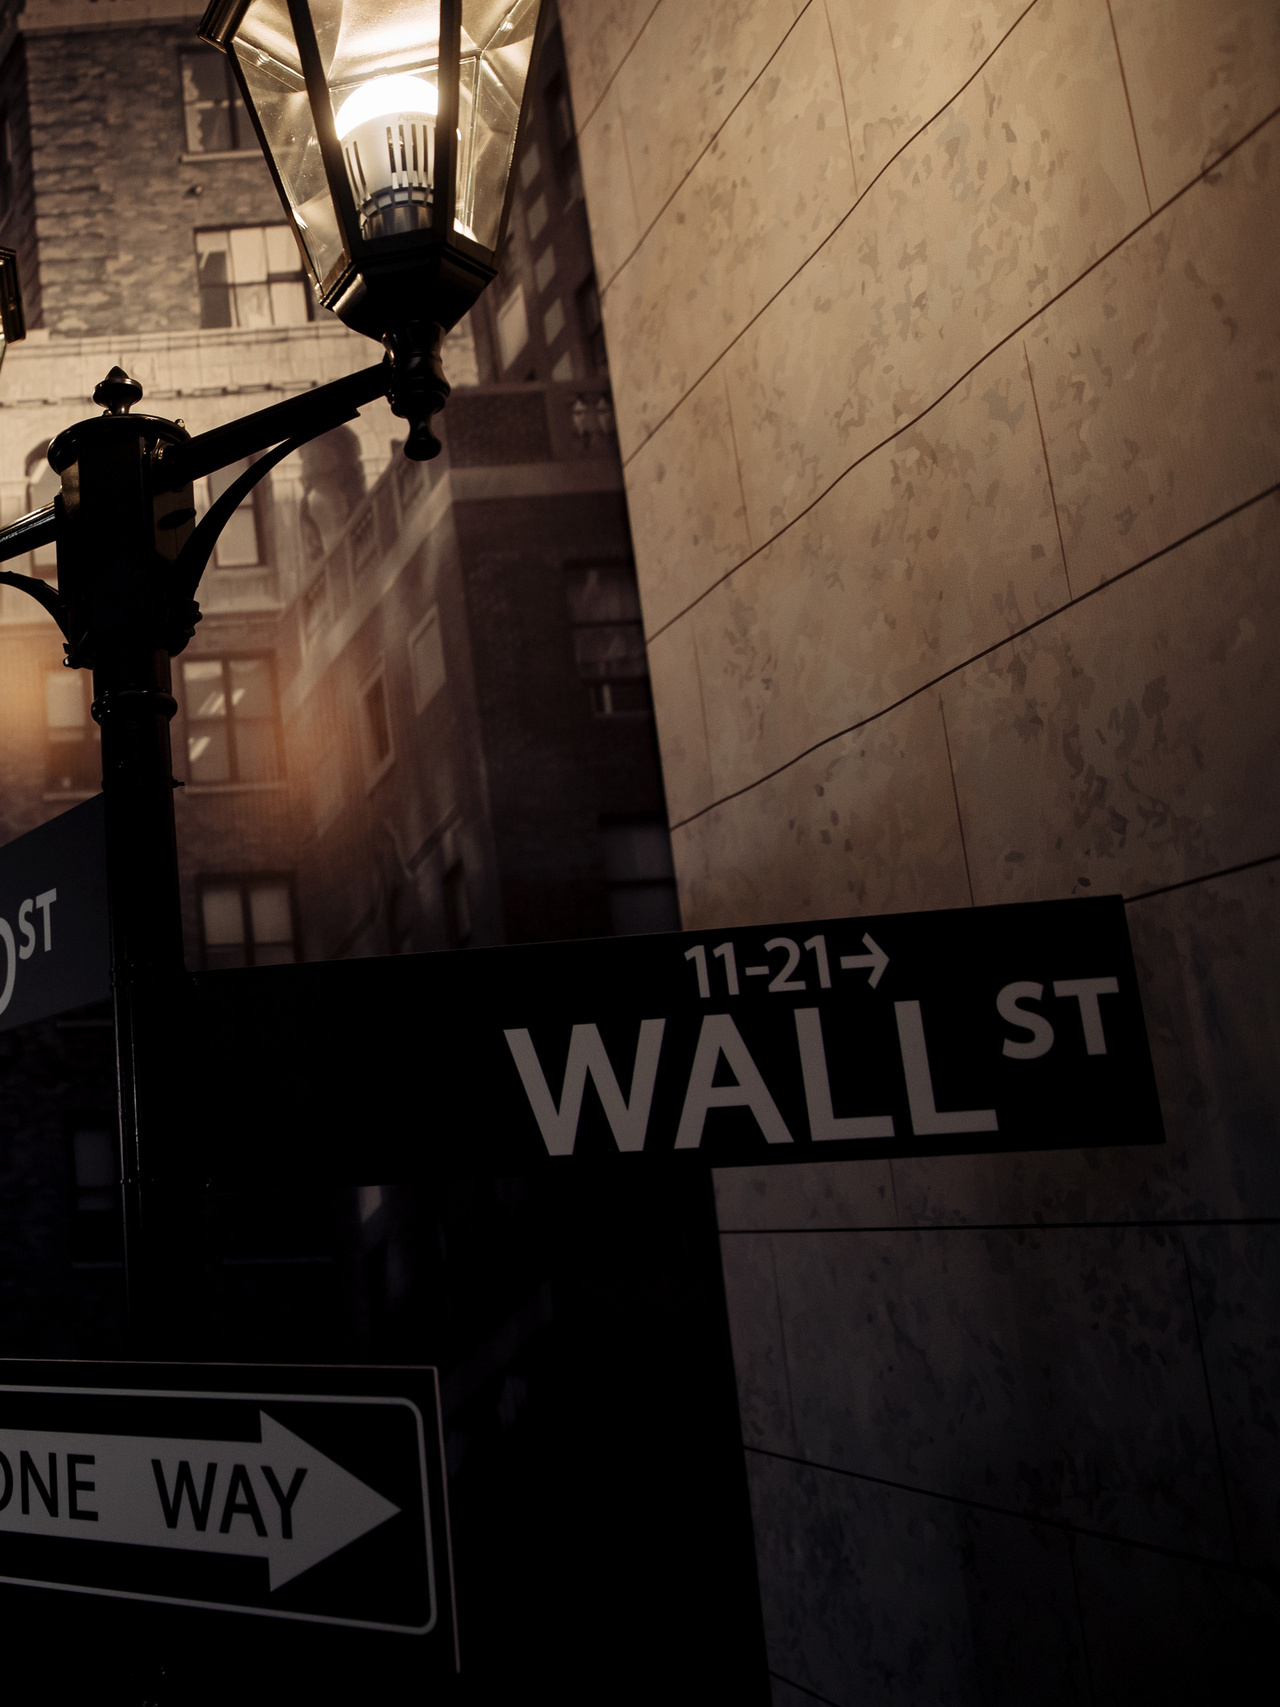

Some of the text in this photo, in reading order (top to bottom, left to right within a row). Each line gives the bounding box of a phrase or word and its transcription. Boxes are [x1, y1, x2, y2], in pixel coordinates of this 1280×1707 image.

[18, 888, 57, 960] ST
[683, 934, 832, 999] 11-21
[503, 976, 1119, 1157] WALL ST
[150, 1458, 308, 1540] WAY
